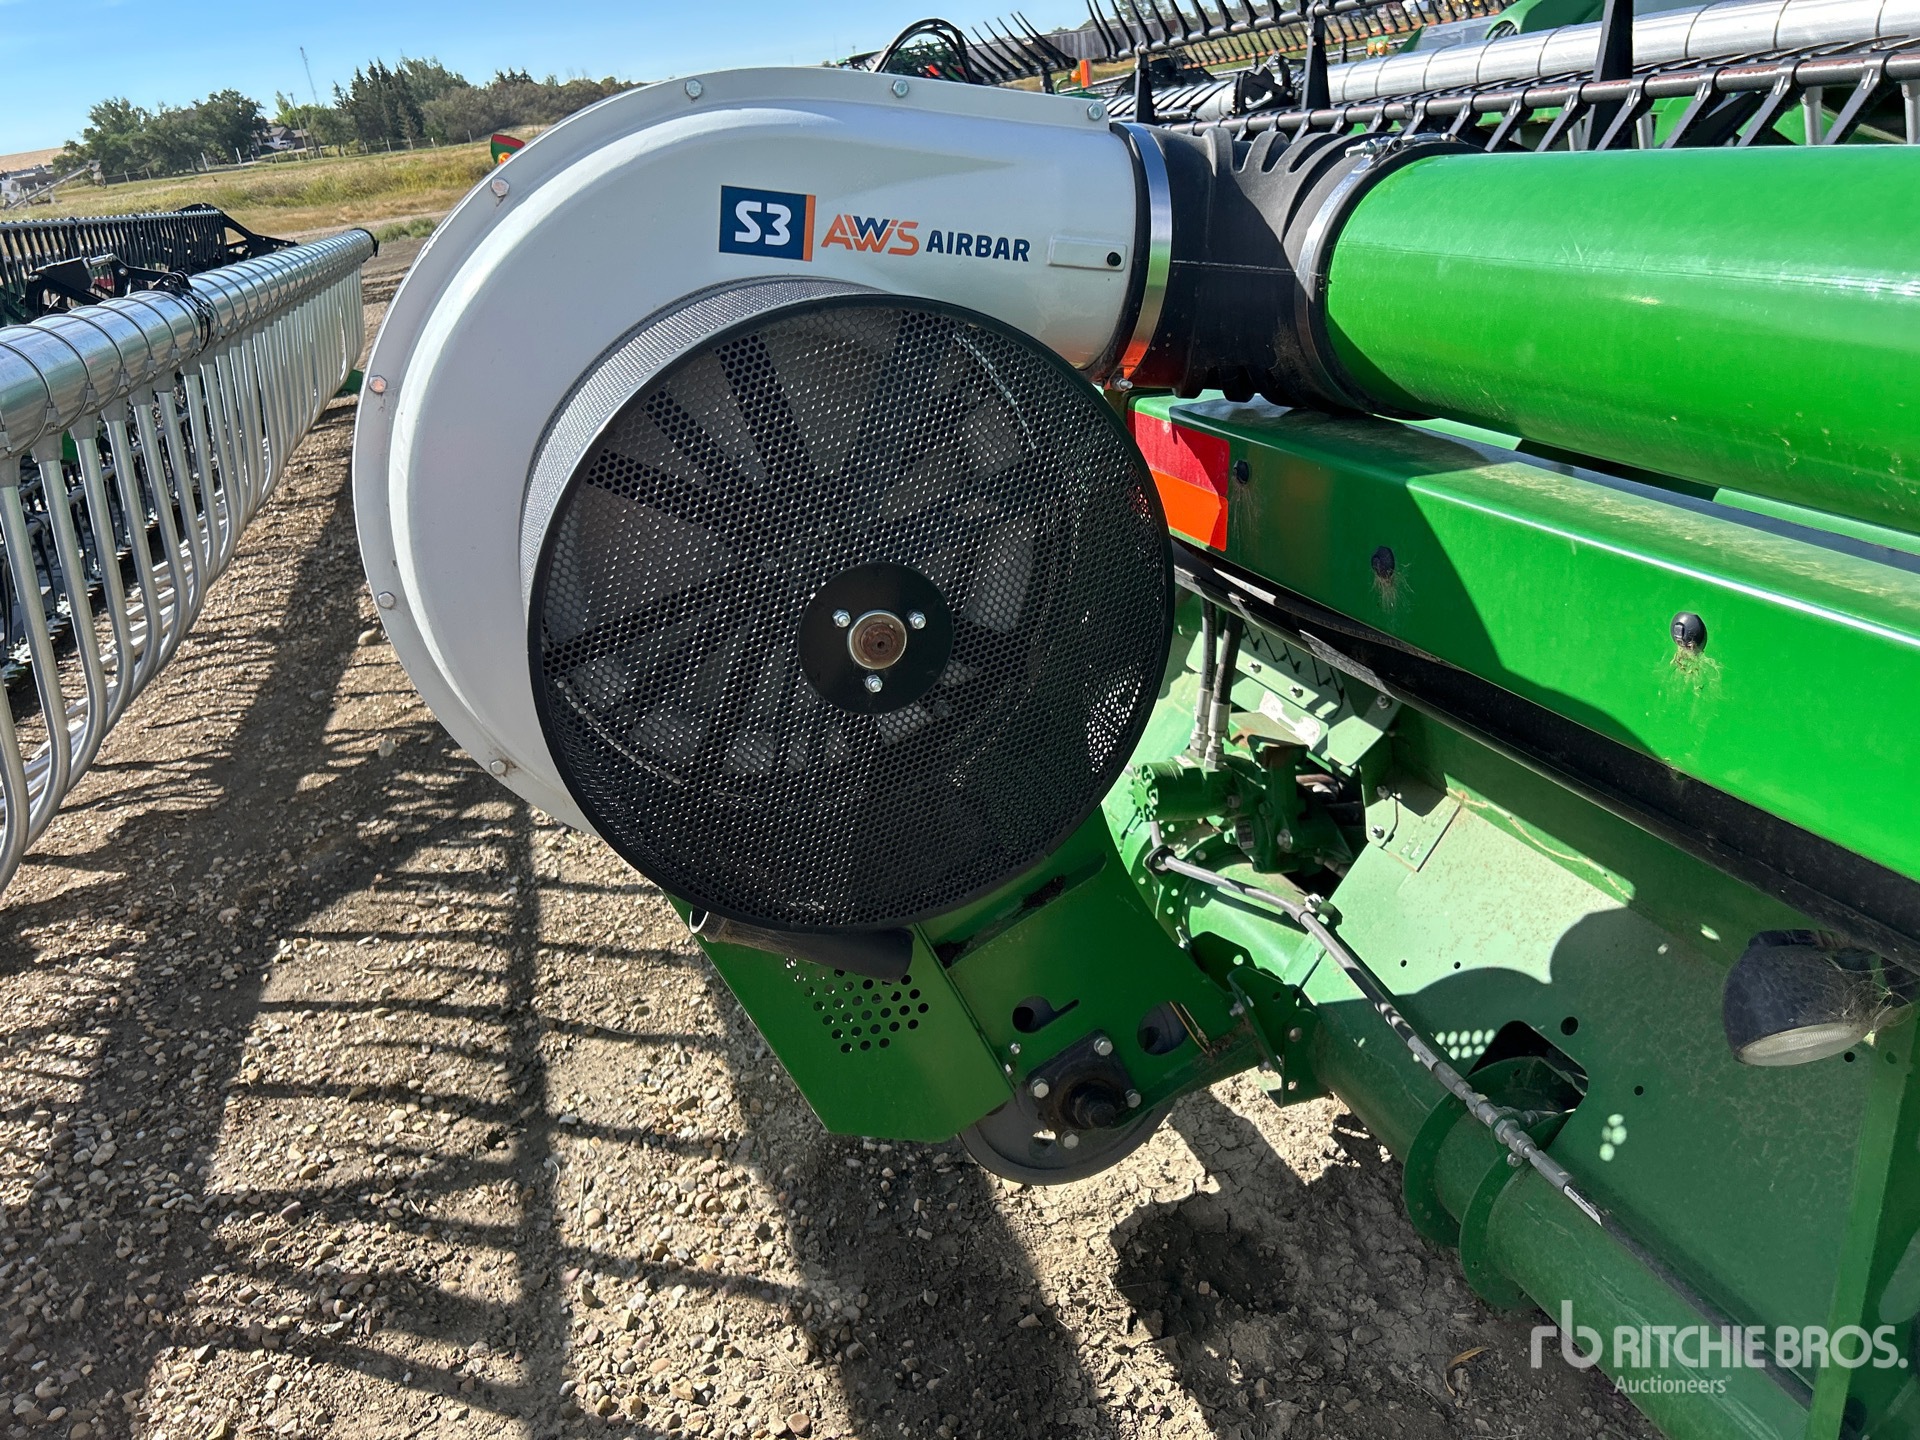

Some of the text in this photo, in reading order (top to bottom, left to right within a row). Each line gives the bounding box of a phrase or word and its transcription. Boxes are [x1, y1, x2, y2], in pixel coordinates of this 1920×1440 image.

[734, 200, 1031, 262] S3 AWS AIRBAR
